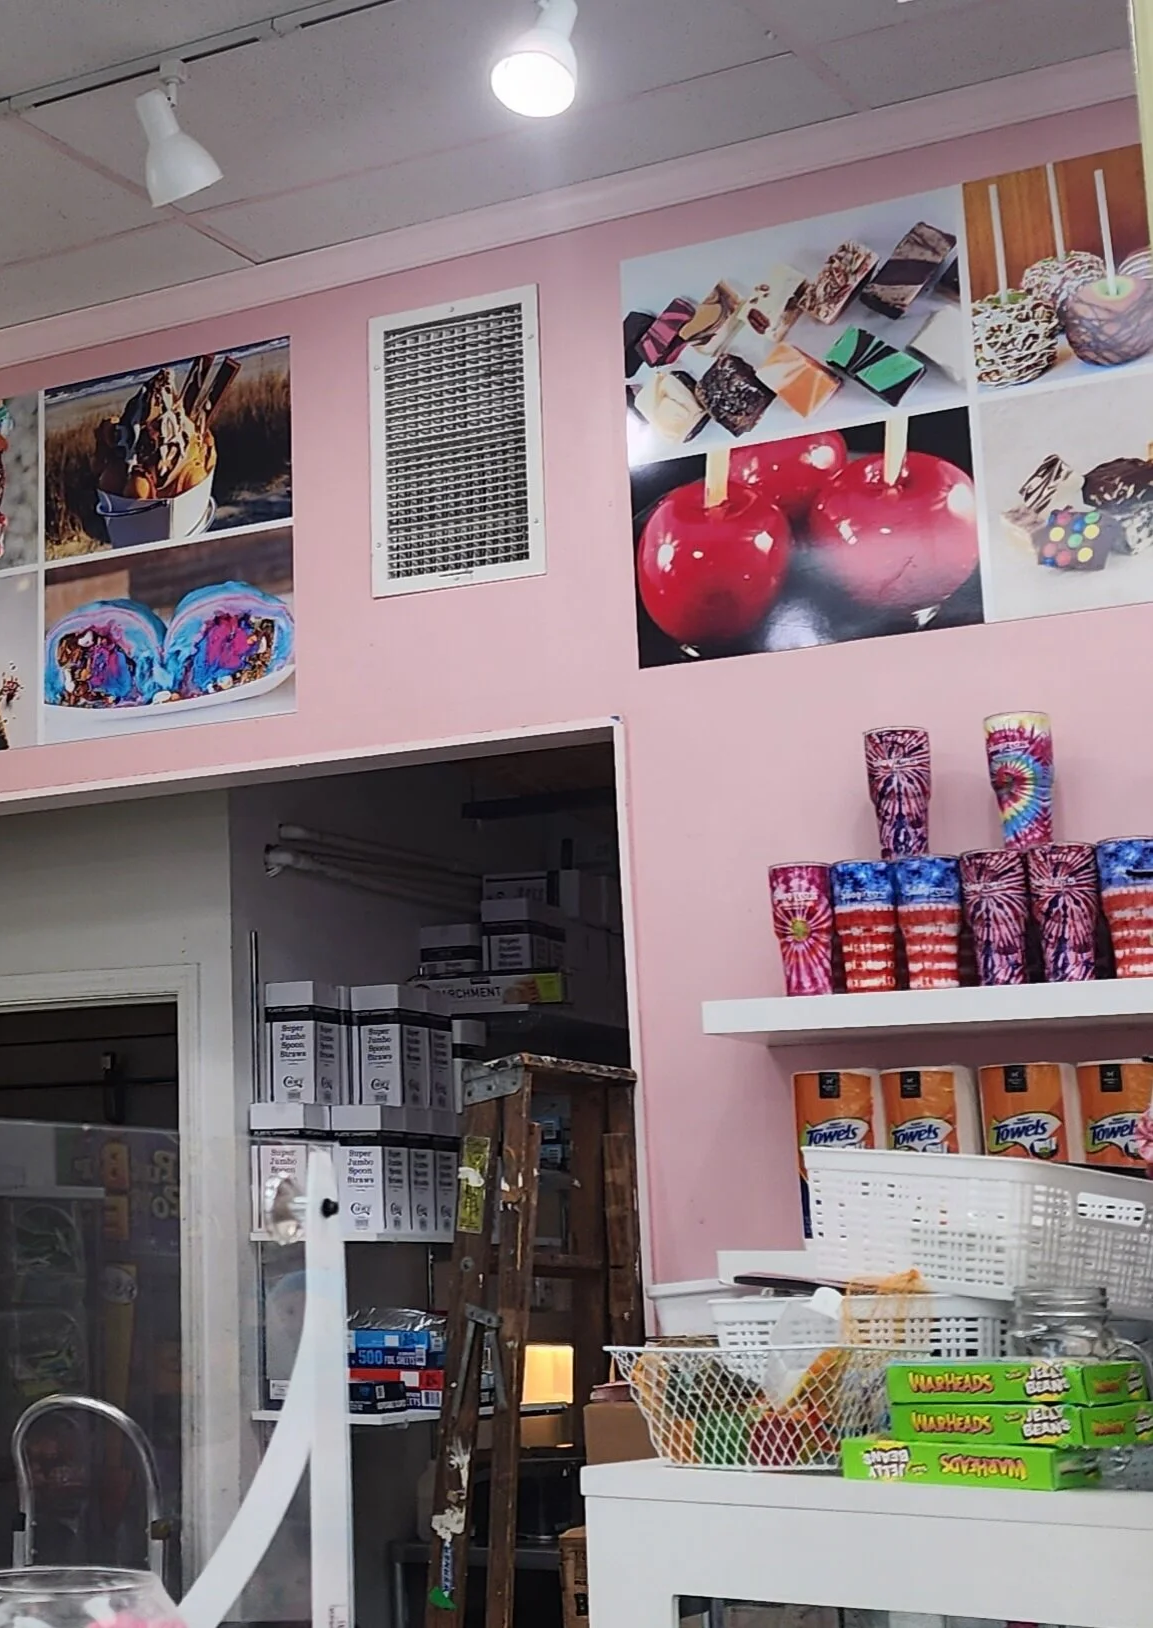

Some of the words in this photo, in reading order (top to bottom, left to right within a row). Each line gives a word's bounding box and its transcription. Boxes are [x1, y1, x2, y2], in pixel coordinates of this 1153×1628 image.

[436, 986, 502, 999] RCHMENT
[280, 1032, 306, 1041] Jumbo
[281, 1024, 304, 1034] Super
[368, 1027, 391, 1037] Super
[367, 1036, 391, 1044] Jumbo
[806, 1124, 860, 1146] Towels
[892, 1124, 941, 1149] Towels
[993, 1118, 1049, 1146] Towels
[1089, 1118, 1138, 1146] Towel
[270, 1149, 295, 1158] Super
[349, 1150, 372, 1159] Super
[270, 1158, 297, 1166] Jumbo
[347, 1158, 374, 1166] Jumbo
[348, 1166, 373, 1175] Spoon
[347, 1176, 374, 1184] Straws
[358, 1349, 383, 1365] 500
[1027, 1363, 1064, 1381] JELLY
[908, 1370, 995, 1394] WARHEADS
[1024, 1377, 1071, 1396] BEANS
[911, 1410, 993, 1434] WARHEADS
[1026, 1405, 1065, 1423] JELLY
[1022, 1418, 1072, 1438] BEANS
[862, 1446, 910, 1465] BEANS
[869, 1463, 906, 1479] JELLY
[938, 1453, 1027, 1481] WARHEADS
